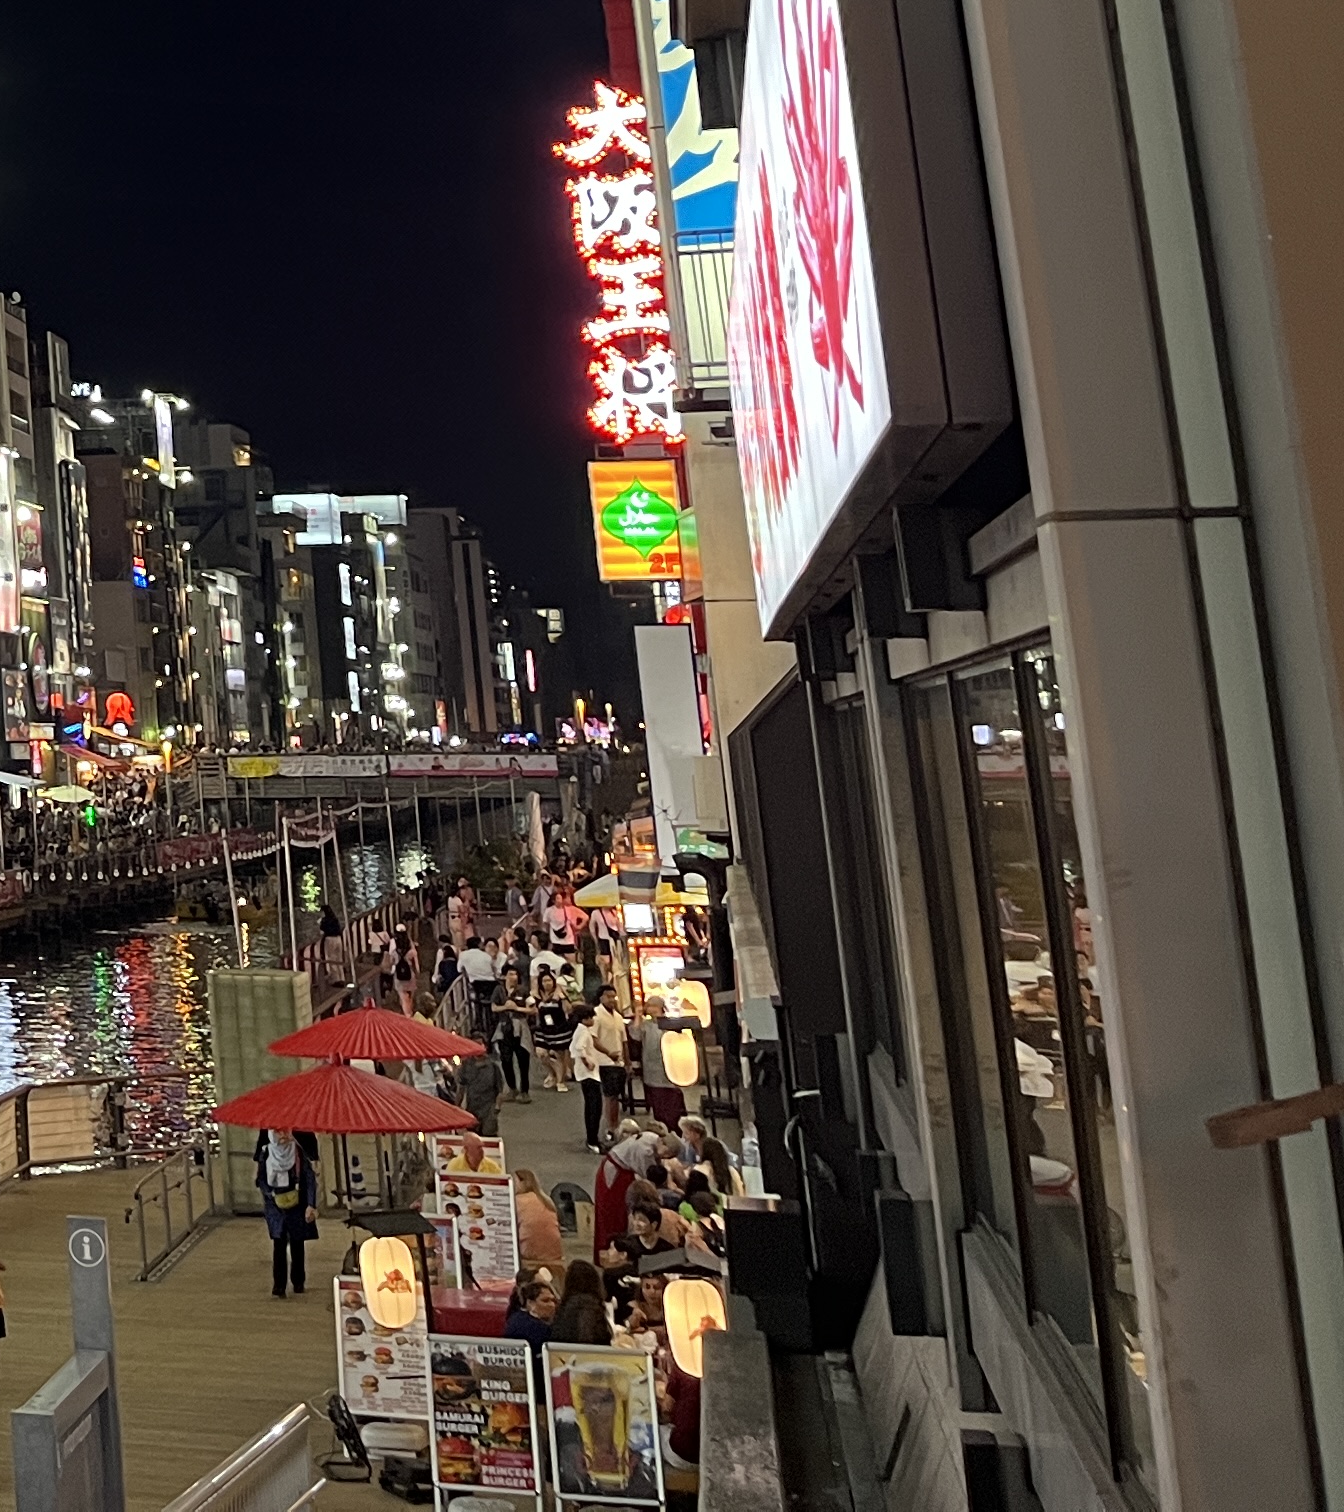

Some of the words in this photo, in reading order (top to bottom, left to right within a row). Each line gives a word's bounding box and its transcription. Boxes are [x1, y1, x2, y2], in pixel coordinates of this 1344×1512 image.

[553, 80, 685, 444] 大阪王将
[649, 553, 680, 573] 2F
[480, 1379, 510, 1391] KING
[435, 1412, 485, 1424] SAMURAI
[435, 1422, 479, 1435] BURGER
